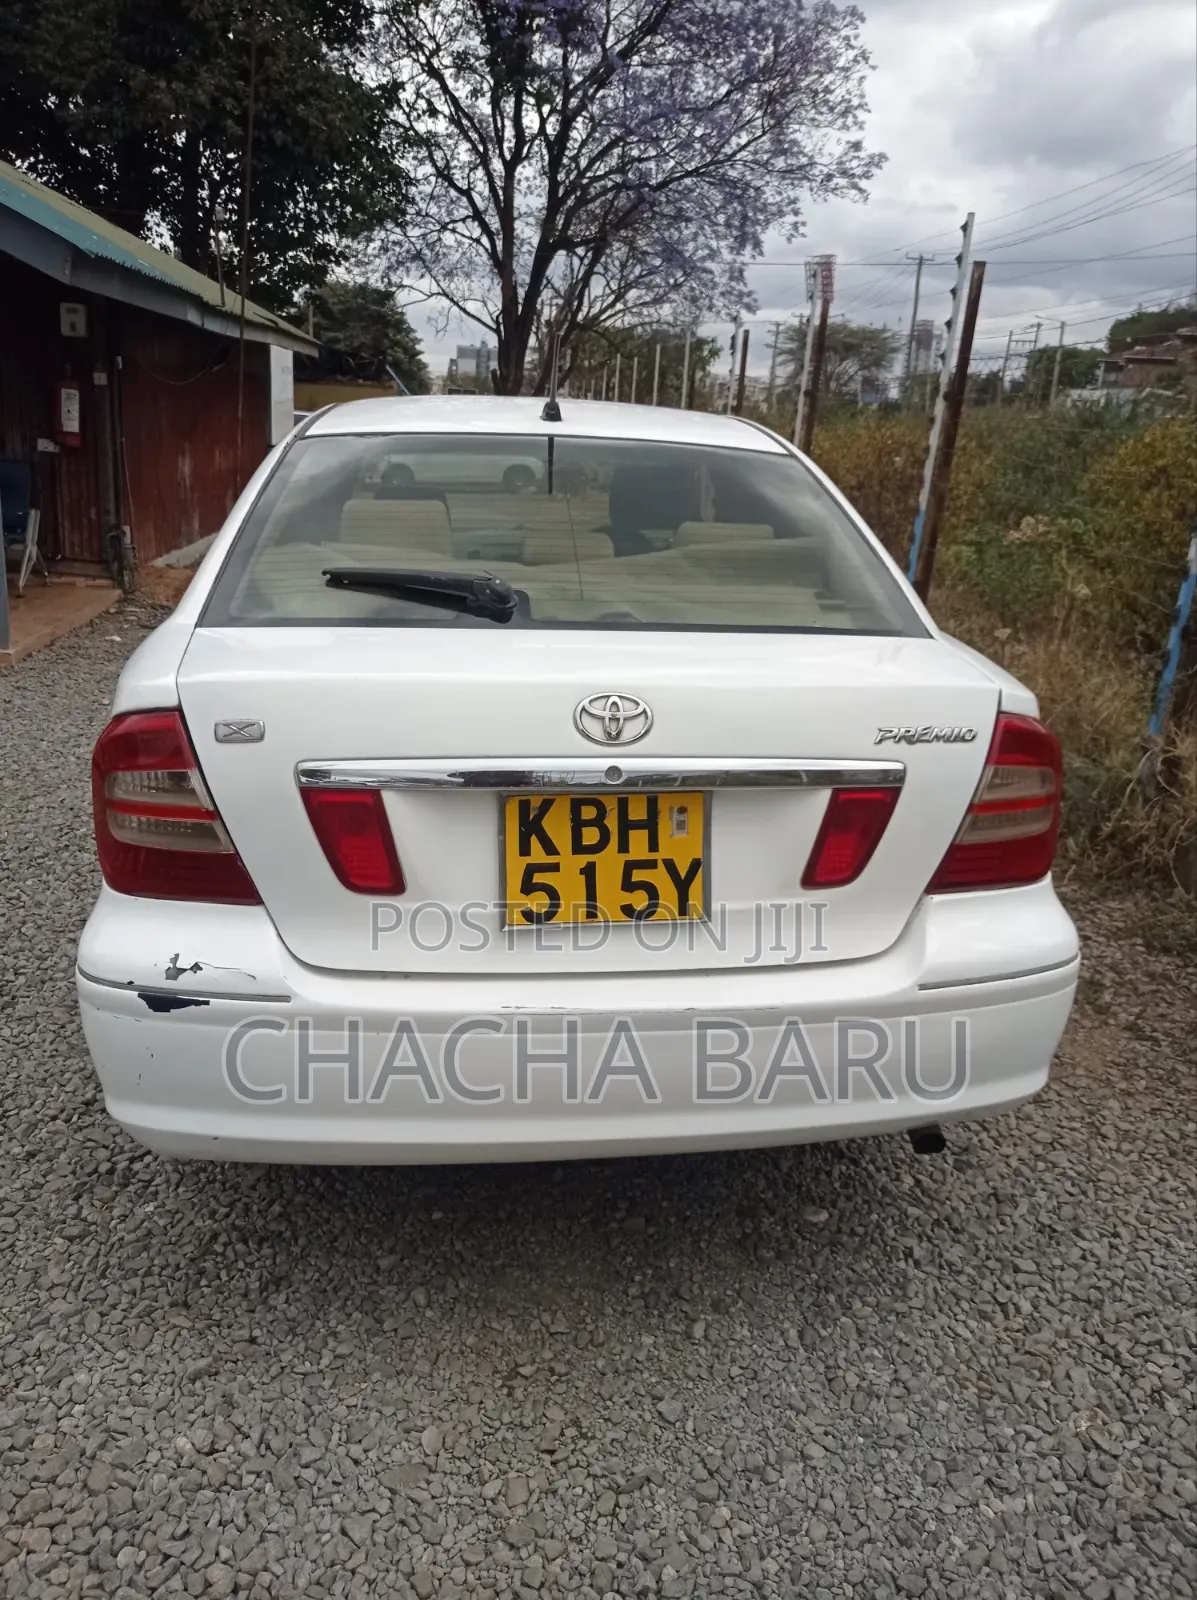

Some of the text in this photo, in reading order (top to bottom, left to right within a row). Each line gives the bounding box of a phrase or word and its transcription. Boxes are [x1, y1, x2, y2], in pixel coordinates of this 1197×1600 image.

[874, 725, 978, 745] PREMIO
[518, 795, 660, 857] KBH
[519, 858, 702, 924] 515Y
